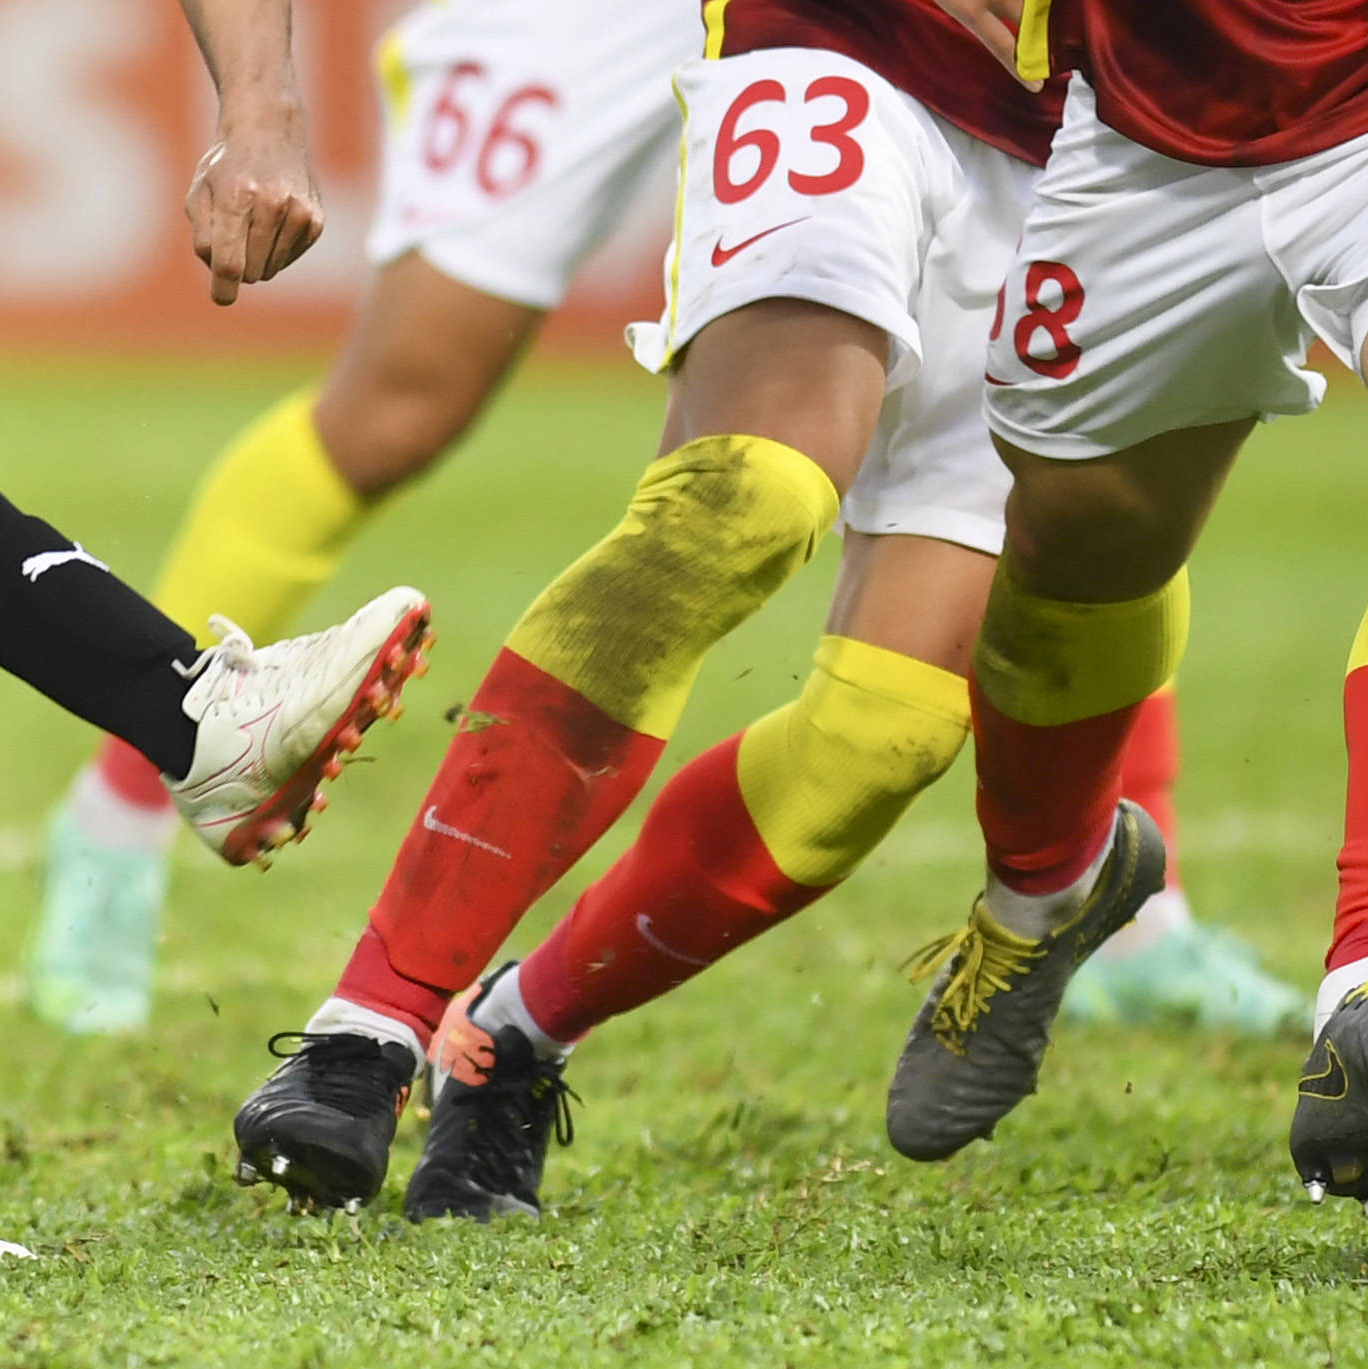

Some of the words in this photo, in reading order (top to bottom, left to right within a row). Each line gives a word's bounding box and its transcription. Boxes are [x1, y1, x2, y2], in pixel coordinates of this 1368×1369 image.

[422, 59, 560, 199] 66
[712, 75, 871, 205] 63
[989, 235, 1085, 380] 8
